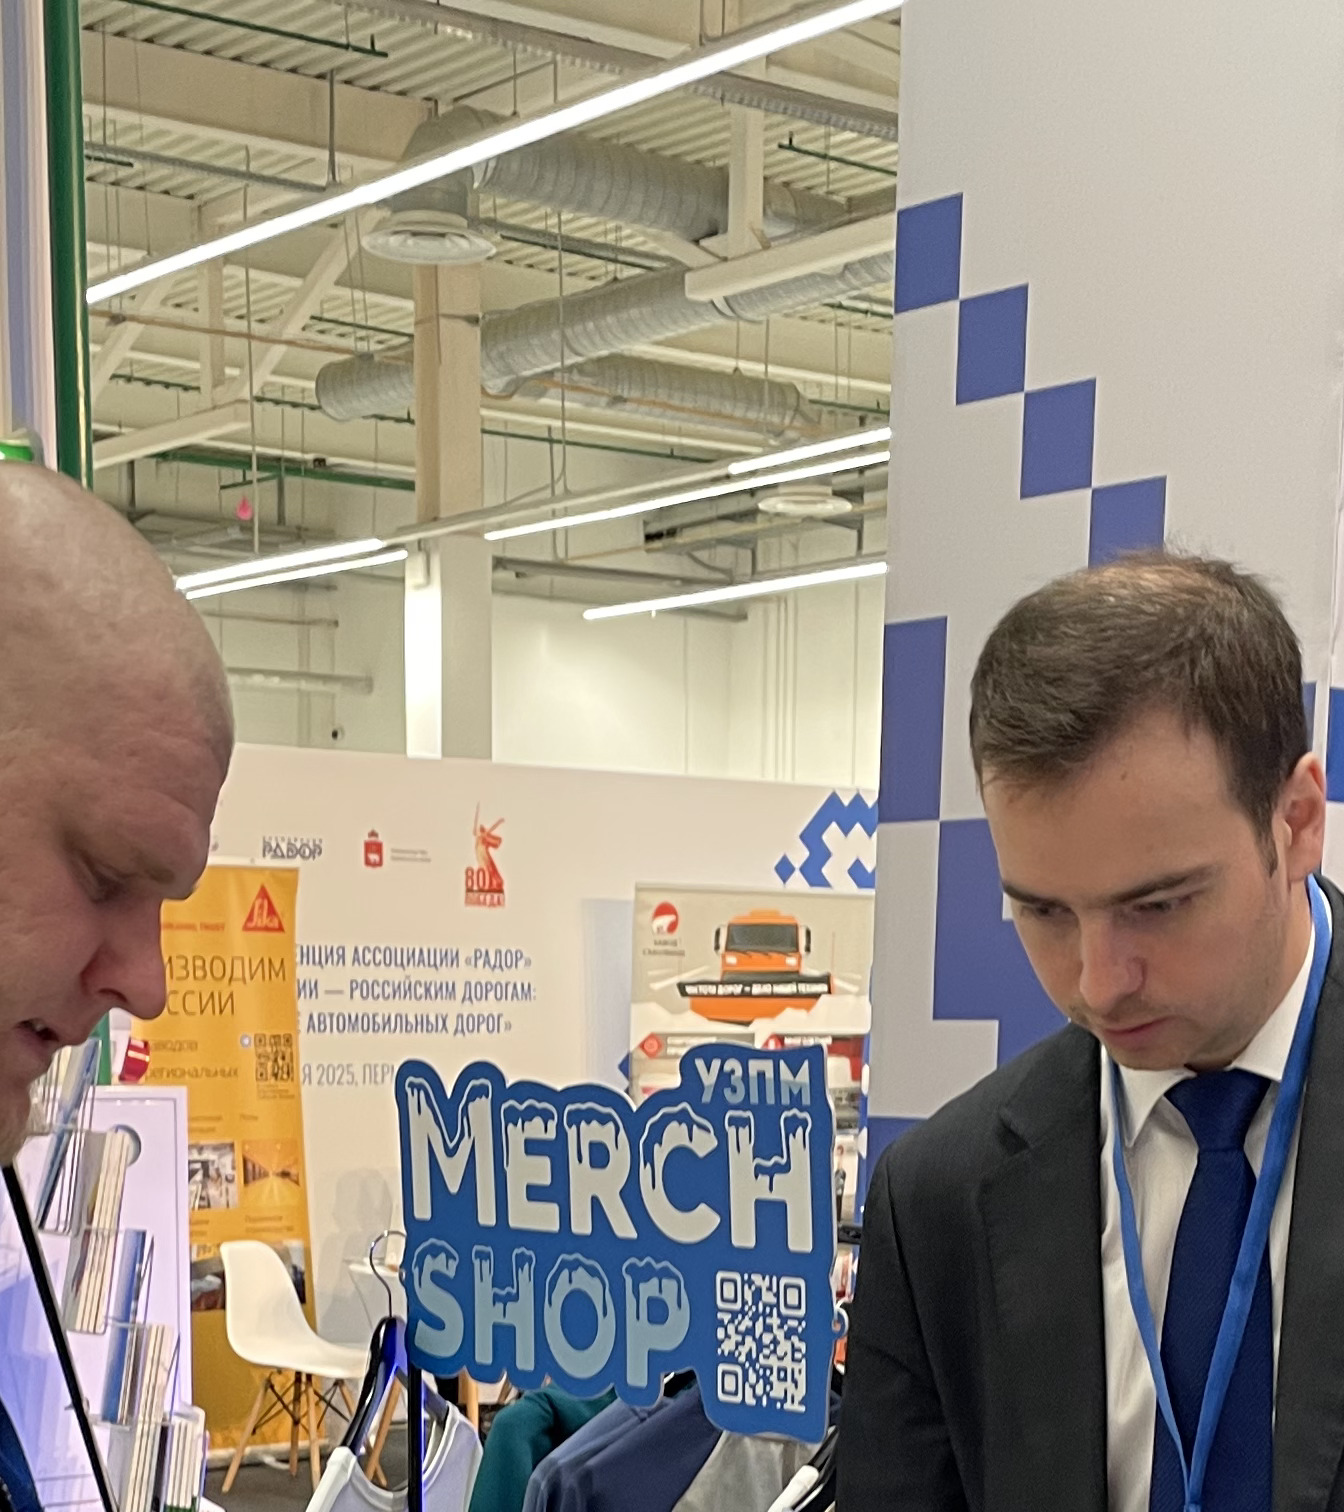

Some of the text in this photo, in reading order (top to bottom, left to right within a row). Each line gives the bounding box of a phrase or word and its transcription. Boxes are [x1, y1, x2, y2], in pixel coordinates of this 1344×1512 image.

[296, 944, 532, 971] НЦИЯ АССОЦИАЦИИ «РАДОР»
[349, 975, 456, 1001] РОССИЙСКИМ
[306, 1011, 449, 1034] АВТОМОБИЛЬНЫХ
[362, 1064, 394, 1086] ПЕР
[695, 1058, 811, 1106] УЗПМ
[405, 1078, 814, 1254] MERCH
[412, 1238, 691, 1389] SHOP
